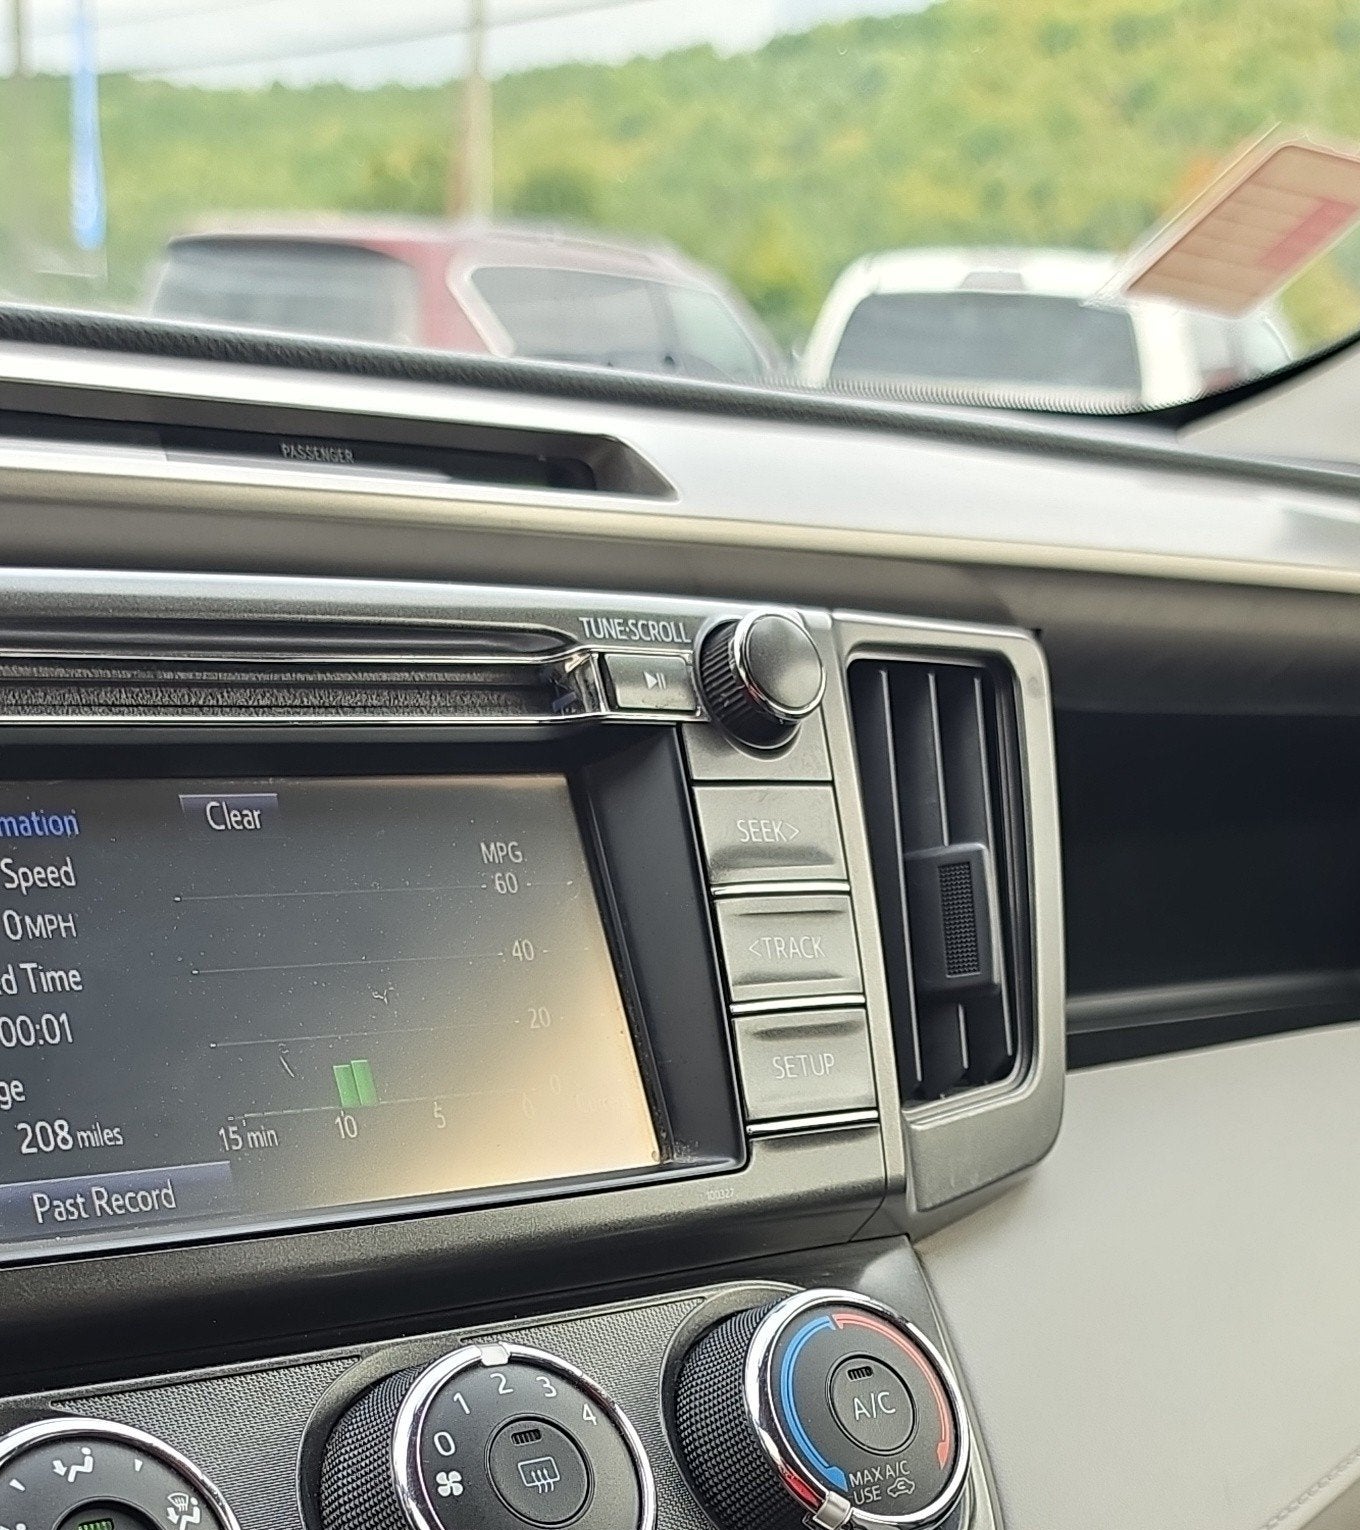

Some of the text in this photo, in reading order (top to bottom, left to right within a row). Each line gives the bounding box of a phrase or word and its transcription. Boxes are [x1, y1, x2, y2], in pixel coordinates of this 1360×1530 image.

[280, 442, 355, 463] PASSENGER
[205, 801, 263, 832] Clear
[480, 841, 524, 865] MPG
[0, 856, 77, 893] Speed
[493, 872, 519, 896] 60
[511, 938, 536, 962] 40
[19, 964, 84, 995] Time
[528, 1006, 552, 1030] 20
[771, 1054, 836, 1080] SETUP
[19, 1122, 123, 1155] 208 miles
[334, 1115, 358, 1139] 10
[218, 1128, 279, 1152] 15 min
[33, 1182, 176, 1224] Past Record
[489, 1373, 514, 1396] 2
[535, 1376, 557, 1398] 3
[452, 1391, 471, 1415] 1
[581, 1403, 598, 1426] 4
[852, 1391, 896, 1420] A/C
[433, 1431, 456, 1457] 0
[849, 1460, 910, 1488] MAX A/C
[853, 1485, 882, 1505] USE
